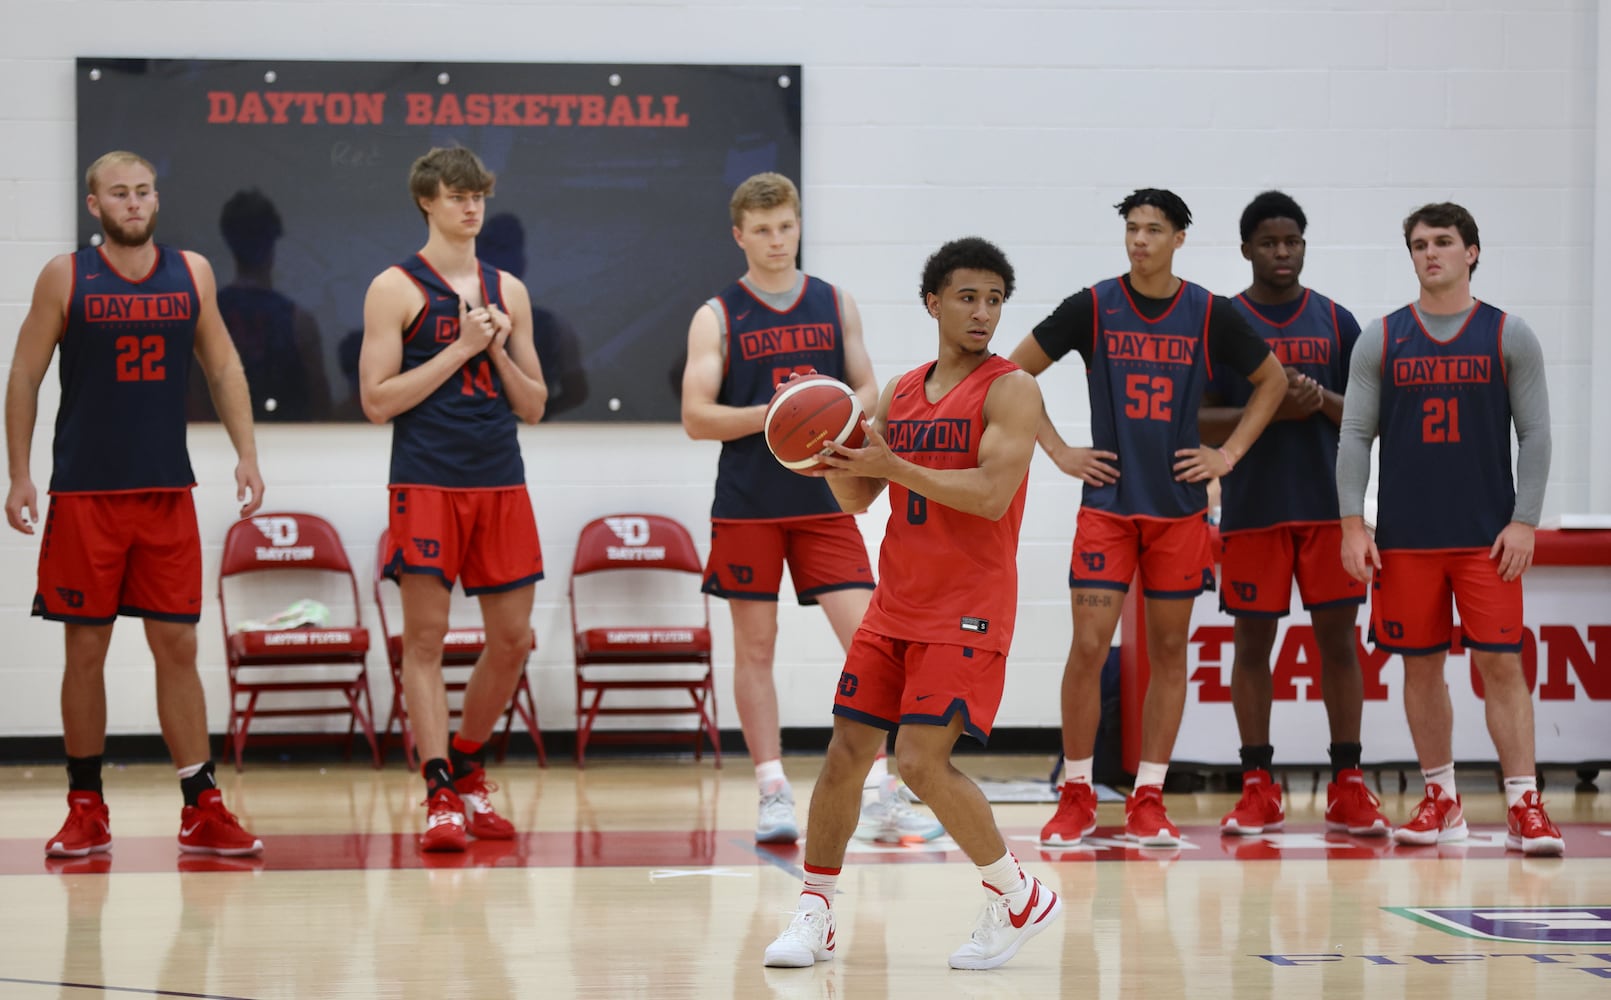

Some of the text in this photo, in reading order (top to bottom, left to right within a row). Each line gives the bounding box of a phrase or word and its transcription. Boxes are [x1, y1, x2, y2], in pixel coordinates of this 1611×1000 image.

[207, 92, 689, 127] DAYTON BASKETBALL
[88, 295, 189, 319] DAYTON
[743, 325, 832, 356] DAYTON
[1104, 334, 1196, 362] DAYTON
[1264, 340, 1328, 362] YTON
[115, 335, 166, 382] 22
[1397, 358, 1488, 382] DAYTON
[461, 361, 498, 397] 14
[1125, 373, 1174, 422] 52
[887, 421, 968, 450] DAYTON
[1422, 397, 1461, 443] 21
[1189, 625, 1611, 702] DAYON
